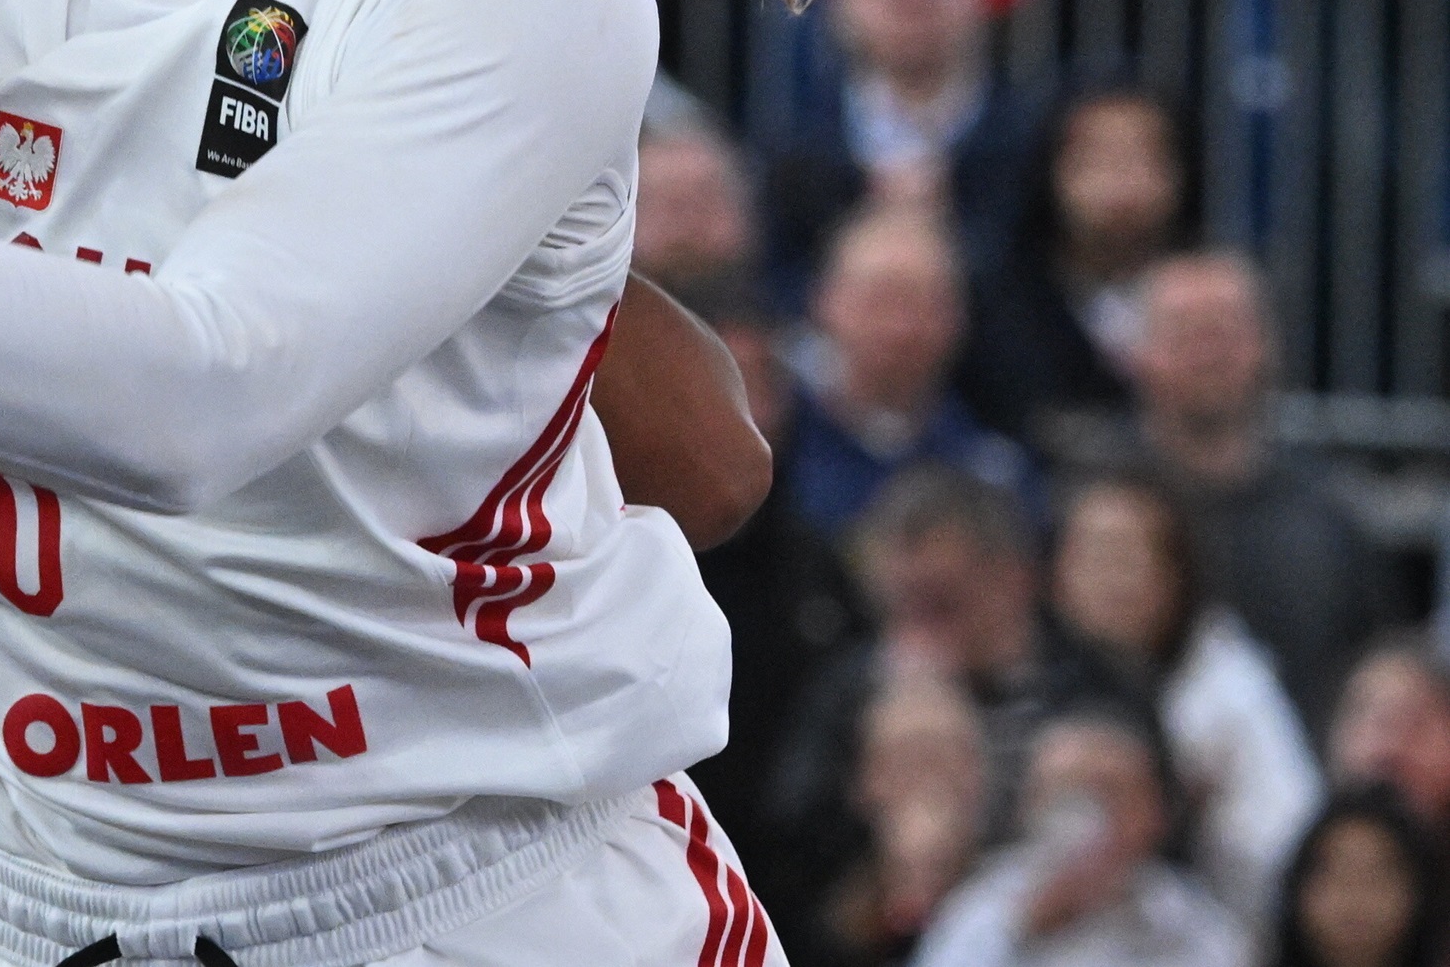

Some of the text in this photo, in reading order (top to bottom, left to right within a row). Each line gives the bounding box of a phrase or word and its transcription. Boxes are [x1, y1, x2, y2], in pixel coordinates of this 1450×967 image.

[219, 95, 269, 142] FIBA
[207, 149, 221, 163] We
[221, 153, 236, 167] Are
[2, 683, 368, 785] ORLEN
